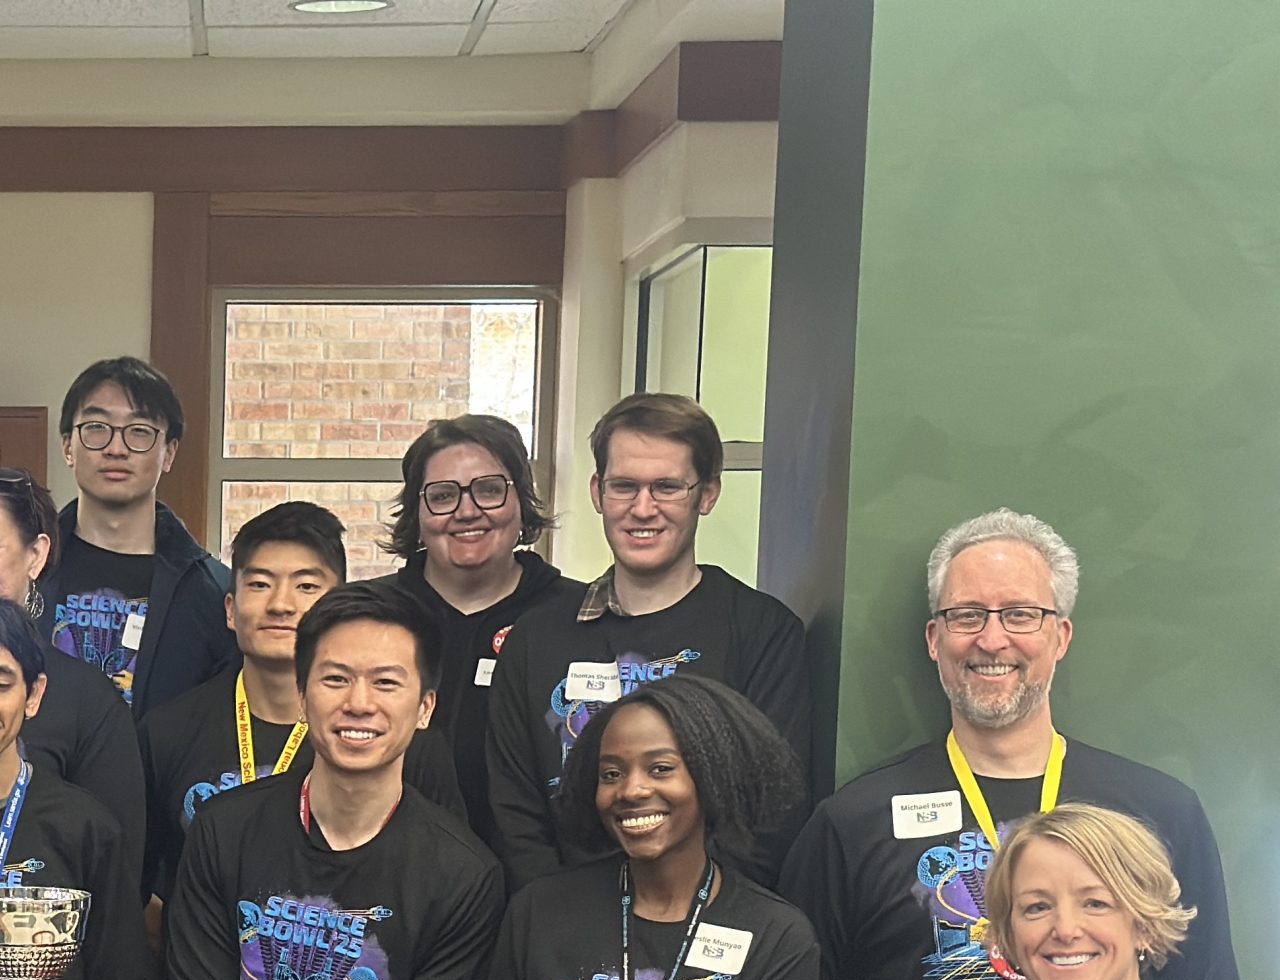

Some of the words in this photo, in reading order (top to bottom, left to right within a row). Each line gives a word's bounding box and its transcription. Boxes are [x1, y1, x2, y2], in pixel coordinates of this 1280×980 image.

[66, 593, 148, 617] SCIENCE
[237, 701, 247, 722] New
[238, 723, 250, 760] Mexico
[900, 802, 930, 811] Michael
[931, 800, 953, 808] Busse
[264, 895, 368, 938] SCIENCE
[712, 938, 742, 951] Munyao
